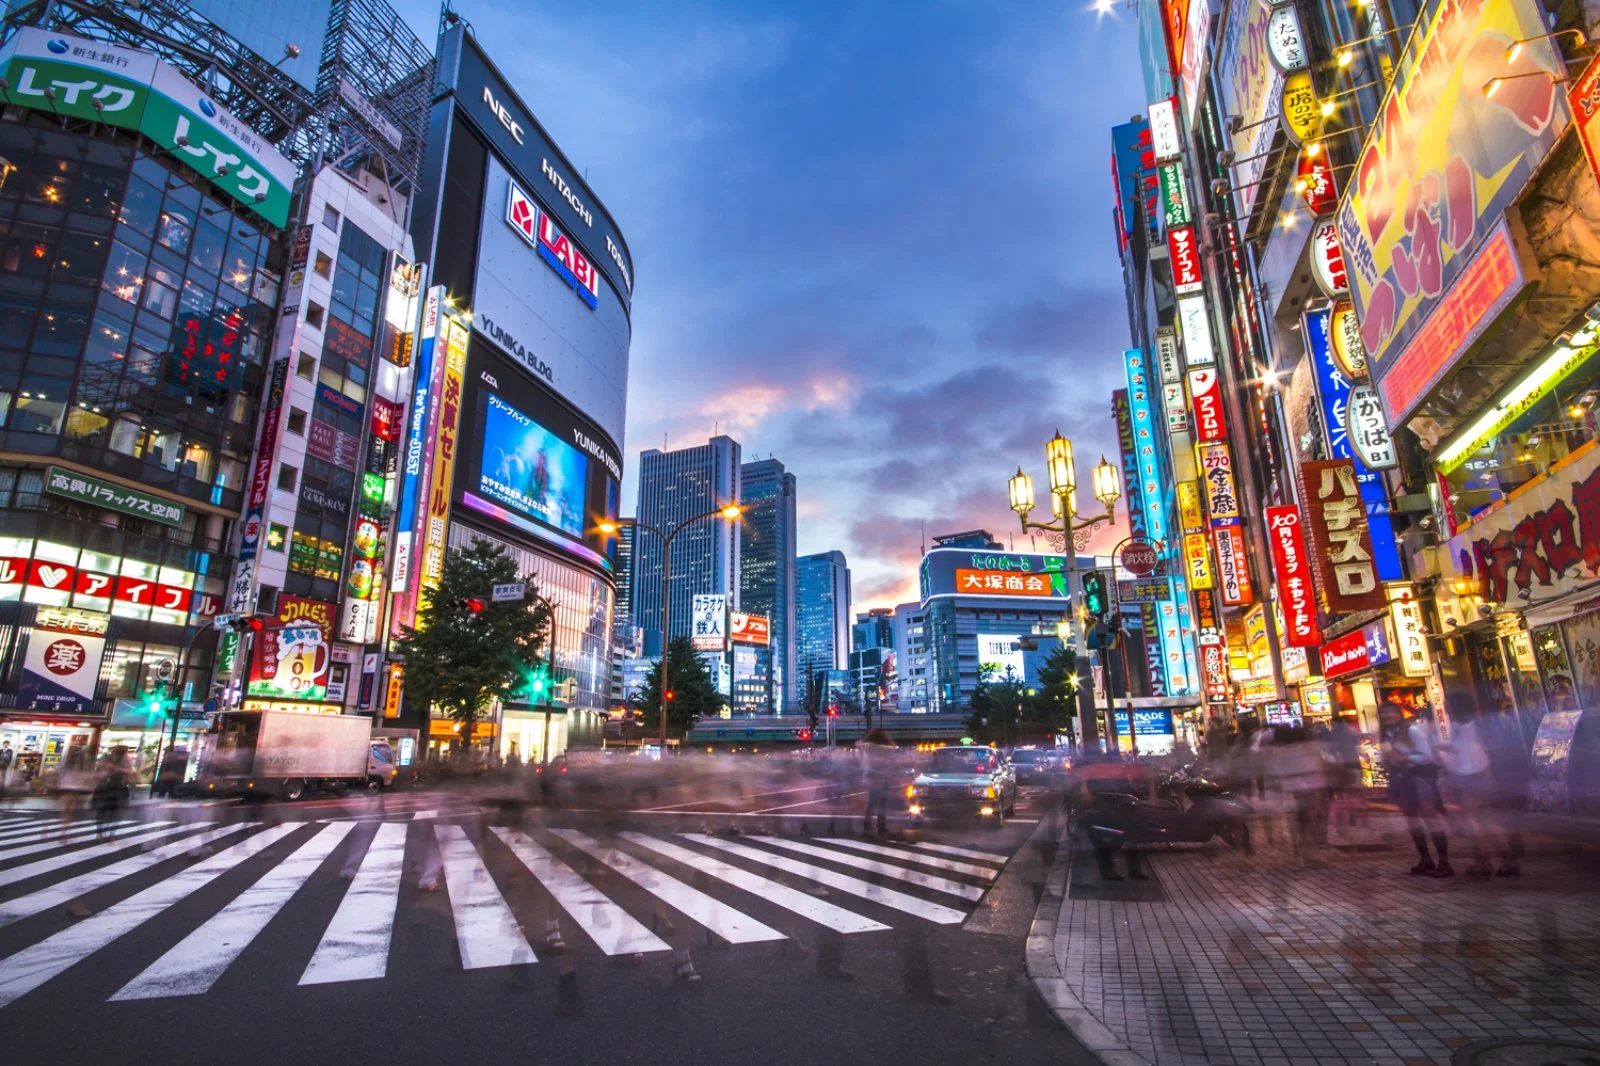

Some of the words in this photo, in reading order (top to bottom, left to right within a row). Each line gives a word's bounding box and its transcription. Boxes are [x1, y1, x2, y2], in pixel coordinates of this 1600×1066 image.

[72, 46, 129, 68] 新生銀行
[1279, 23, 1299, 61] たぬき
[1289, 60, 1303, 69] 5F
[17, 67, 136, 112] レイク
[483, 86, 525, 145] NEC
[1289, 92, 1316, 127] 虎の子
[218, 115, 263, 154] 新生銀行
[1304, 128, 1319, 138] 4F
[173, 114, 270, 198] レイク
[541, 158, 592, 227] HITACHI
[539, 211, 599, 298] LABI
[1176, 243, 1196, 284] アイフル
[429, 305, 438, 327] LABI
[481, 314, 527, 362] YUNIKA
[527, 352, 554, 383] BLDG.
[1341, 313, 1366, 369] お好み焼き
[416, 388, 427, 407] For
[489, 396, 531, 427] クリープハイプ
[1200, 396, 1218, 429] アコム
[1205, 430, 1219, 438] 3F
[1358, 400, 1389, 447] かっぱ
[405, 439, 422, 476] JUST
[573, 428, 606, 463] YUNIKA
[1371, 451, 1391, 462] B1
[1205, 456, 1229, 468] 270
[253, 459, 270, 503] アイフル
[1123, 453, 1146, 533] エスパス
[1208, 467, 1236, 514] 金の蔵
[1358, 474, 1376, 482] 3F
[1220, 518, 1233, 526] 2F
[1318, 464, 1376, 596] パチスロ
[398, 556, 406, 580] LABI
[971, 554, 1031, 572] たのめーる
[1124, 551, 1155, 565] 消火栓
[1217, 531, 1238, 600] 東京チカラめし
[231, 563, 252, 612] 大勝軒
[963, 575, 1043, 591] 大塚商会
[694, 597, 724, 611] カラオケ
[705, 612, 713, 622] の
[696, 621, 720, 635] 鉄人
[749, 621, 767, 632] アコム
[47, 642, 83, 670] 薬
[225, 635, 238, 666] レイク
[989, 642, 1014, 655] TIPNES
[1147, 642, 1166, 697] エスパス
[1207, 648, 1222, 685] 居酒屋
[36, 694, 55, 702] MINE
[1114, 712, 1166, 721] SUNADE
